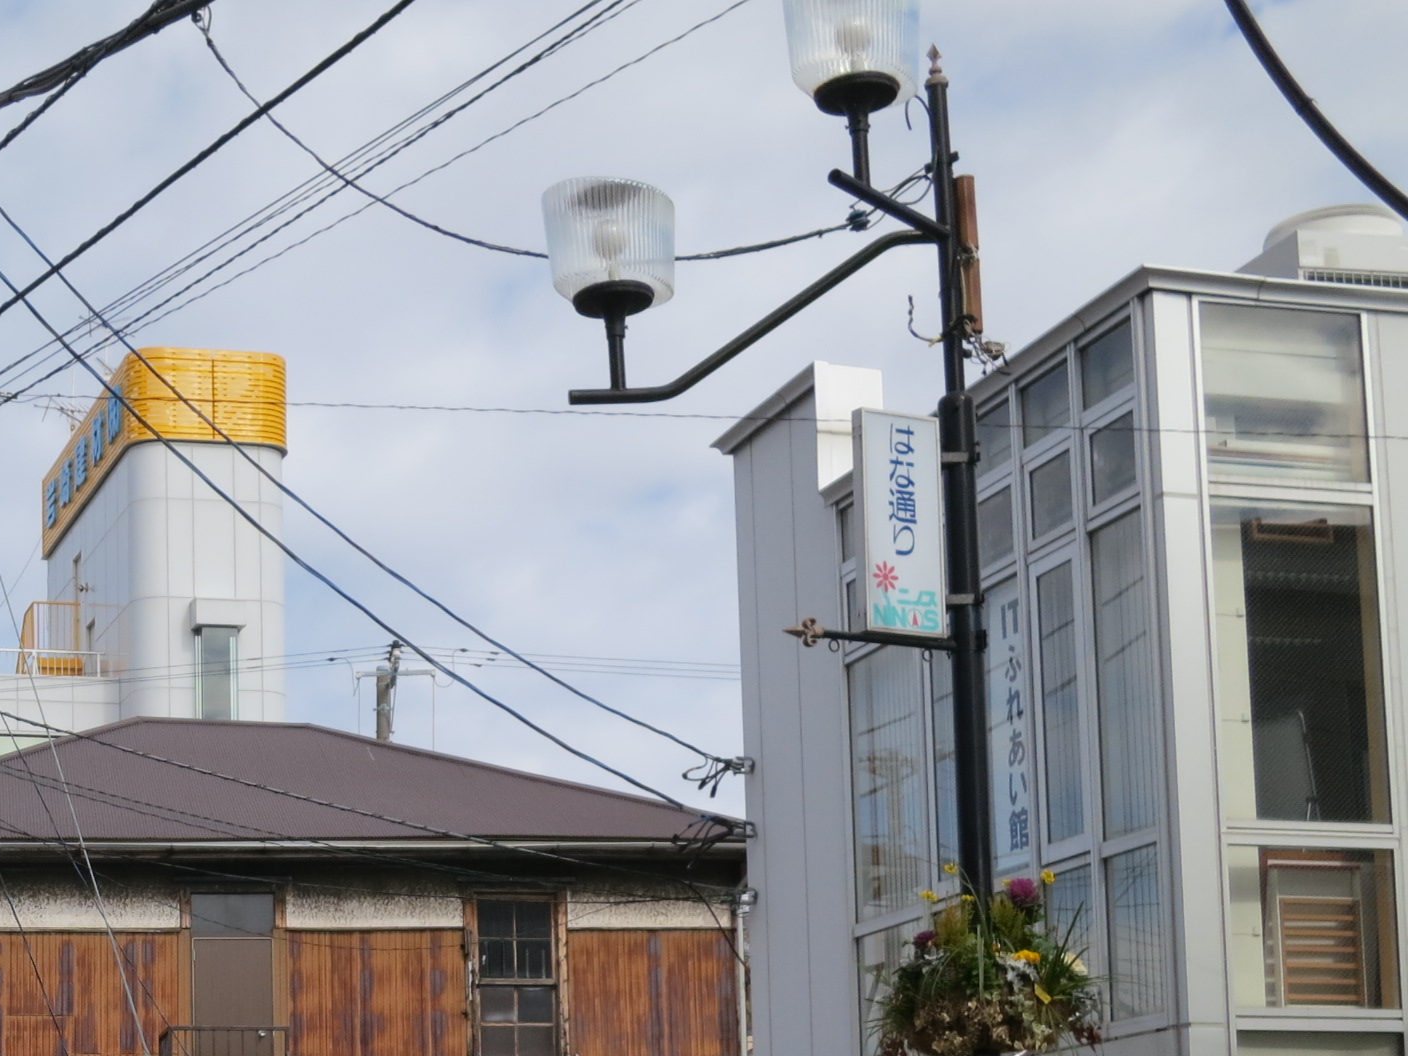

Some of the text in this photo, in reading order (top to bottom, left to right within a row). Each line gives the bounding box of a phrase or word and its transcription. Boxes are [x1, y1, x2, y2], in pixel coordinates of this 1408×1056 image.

[888, 422, 918, 556] はな通り
[1000, 597, 1029, 852] ITふれあい館
